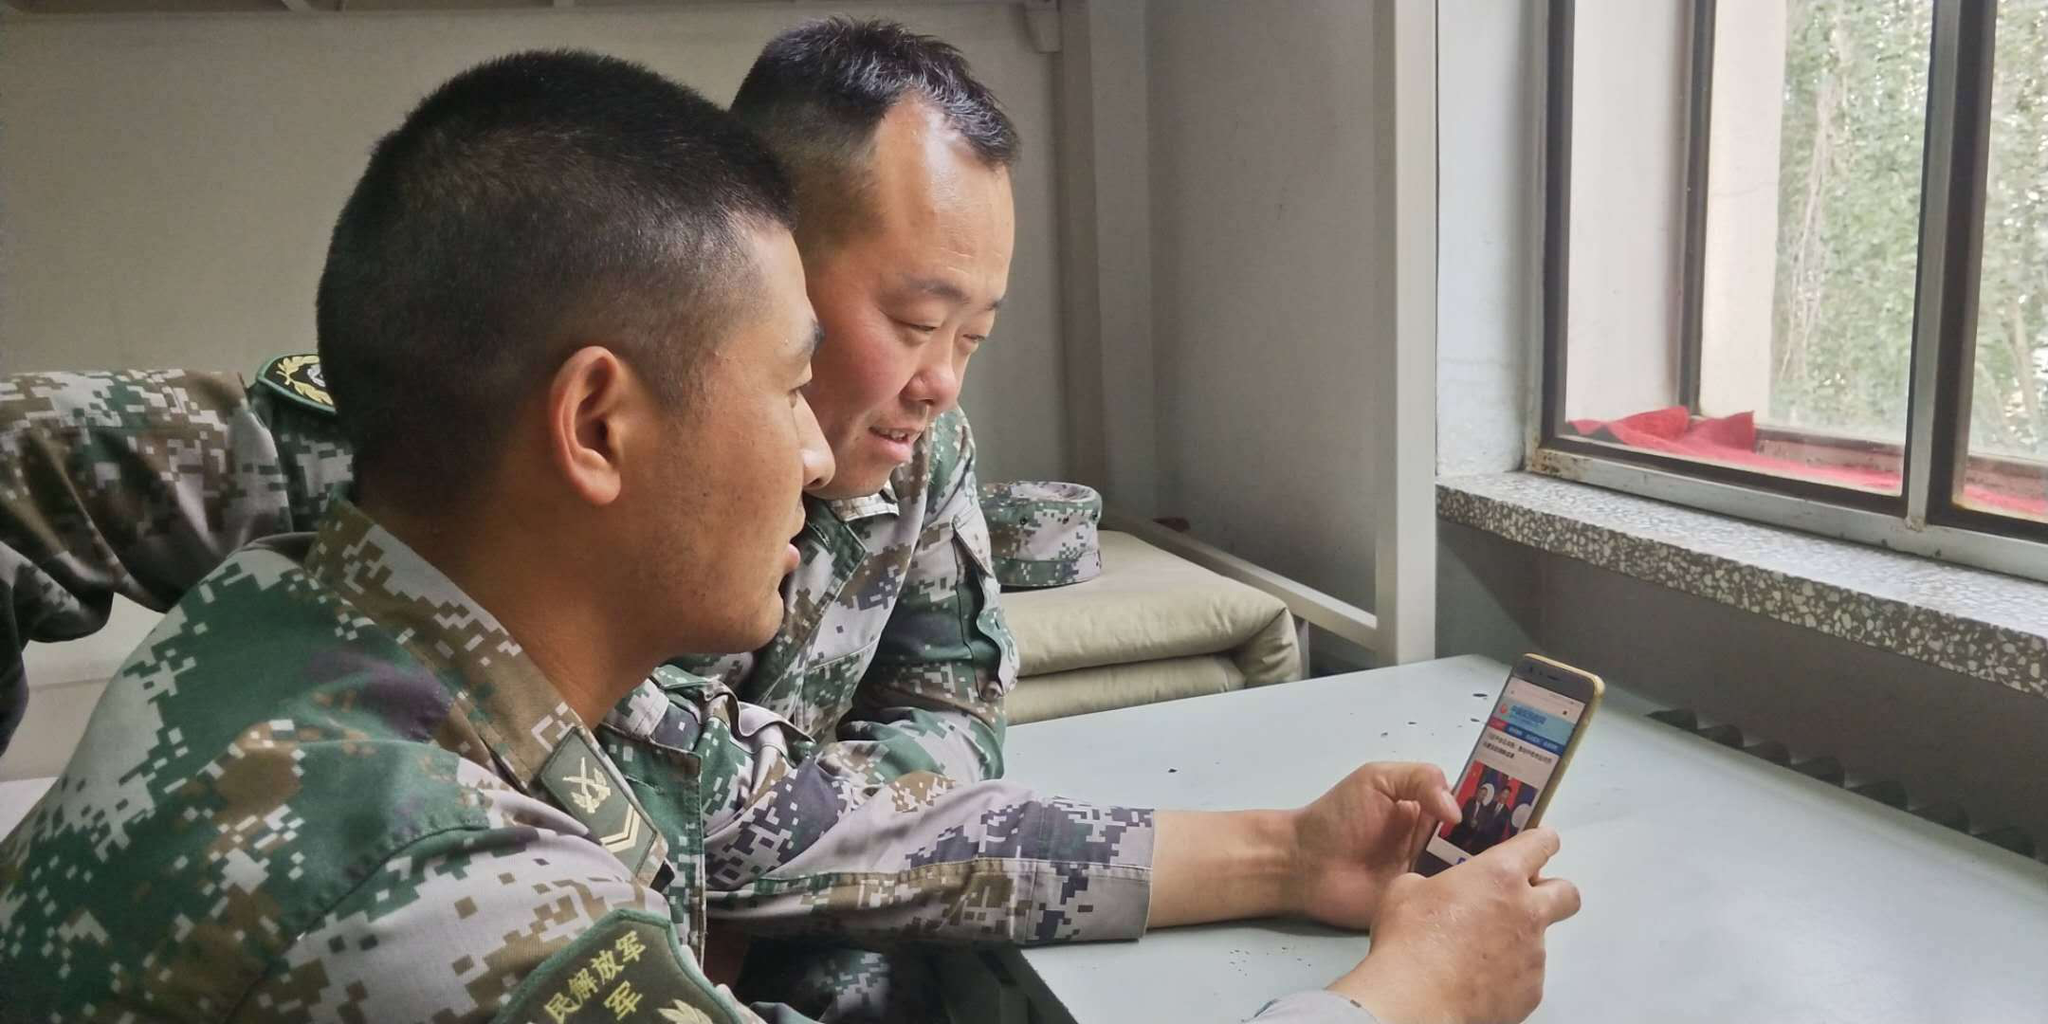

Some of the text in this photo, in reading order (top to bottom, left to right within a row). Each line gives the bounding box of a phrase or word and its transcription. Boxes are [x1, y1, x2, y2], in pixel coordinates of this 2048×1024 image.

[545, 931, 646, 1024] 民解放军
[603, 980, 642, 1020] 军
